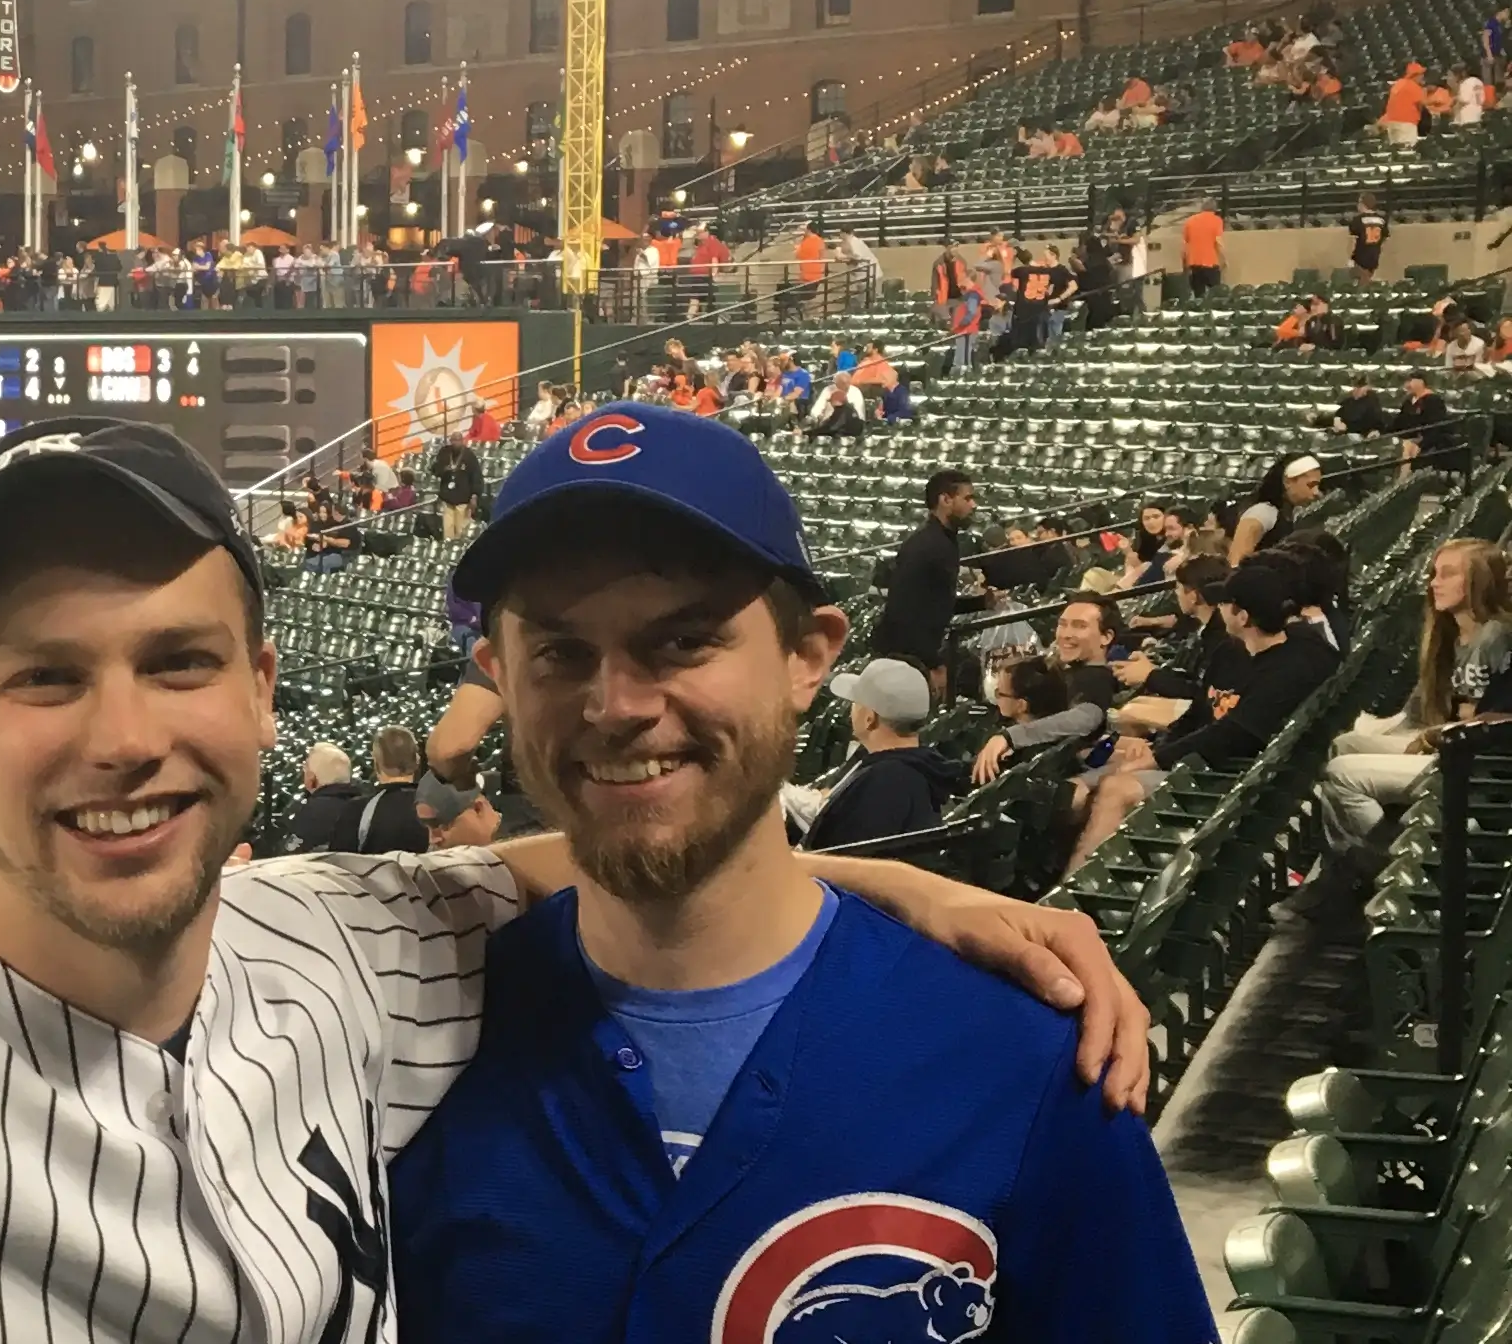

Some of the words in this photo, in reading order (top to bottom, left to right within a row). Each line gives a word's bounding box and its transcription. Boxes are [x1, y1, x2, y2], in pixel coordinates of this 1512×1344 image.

[26, 348, 40, 373] 2
[156, 348, 171, 373] 3
[187, 357, 199, 376] 4
[25, 376, 40, 401] 4
[156, 377, 171, 403] 0
[568, 413, 646, 465] C
